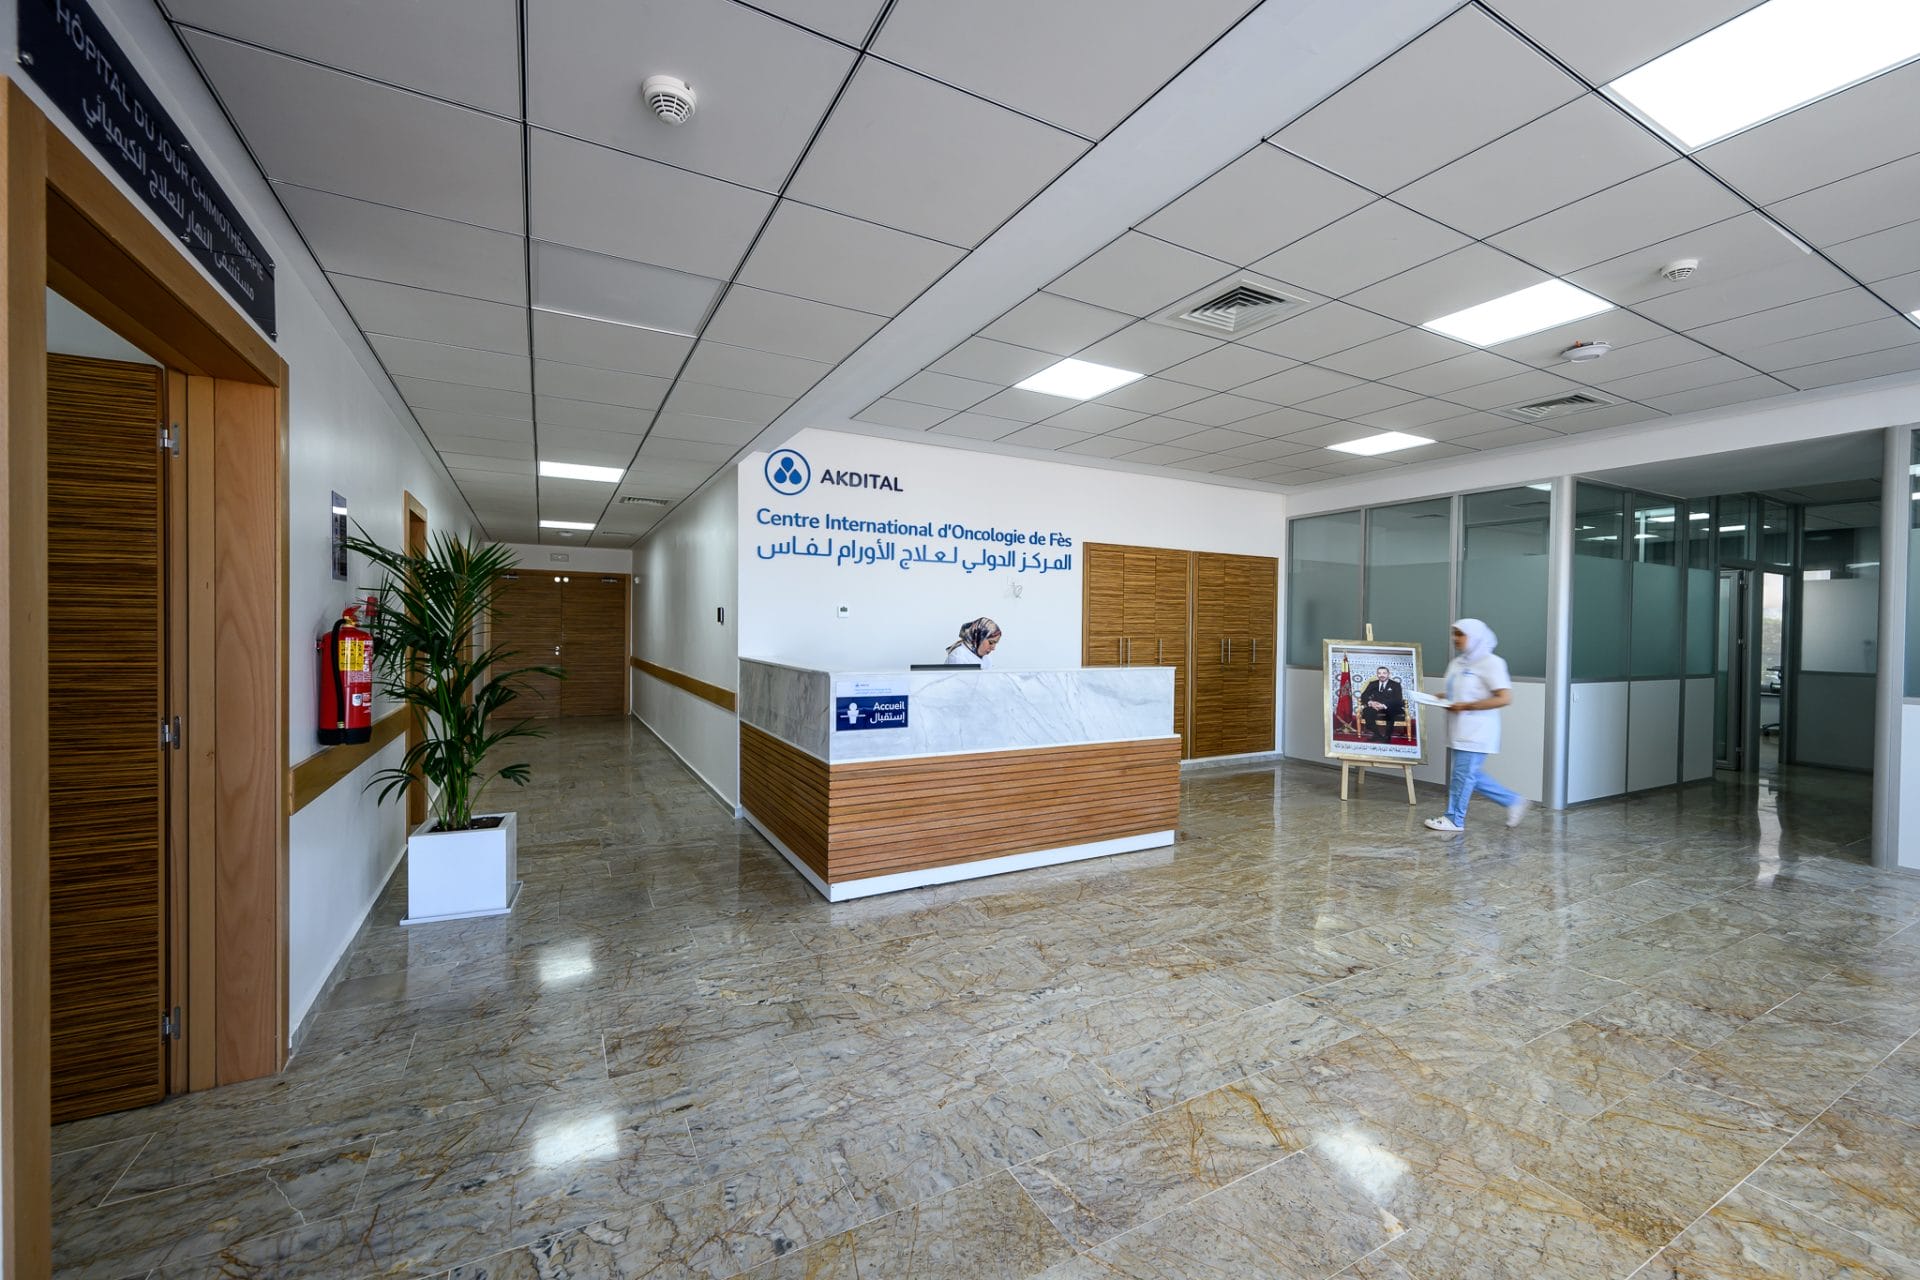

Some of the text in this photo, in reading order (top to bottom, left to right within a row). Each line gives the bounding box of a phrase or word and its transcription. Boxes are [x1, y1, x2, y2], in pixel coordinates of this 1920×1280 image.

[56, 0, 264, 281] HÔPITAL DU JOUR CHIMIOTHÉRAPIE
[82, 94, 146, 176] الكيميائي
[186, 211, 213, 253] النهار
[214, 250, 255, 301] مستشفى
[820, 468, 904, 492] AKDITAL
[756, 508, 1073, 547] Centre International d'Oncologie de Fès
[757, 535, 1072, 574] المركز الدولي لعلاج الأورام لفاس
[869, 711, 905, 724] إستقبال
[872, 701, 905, 711] Accueil
